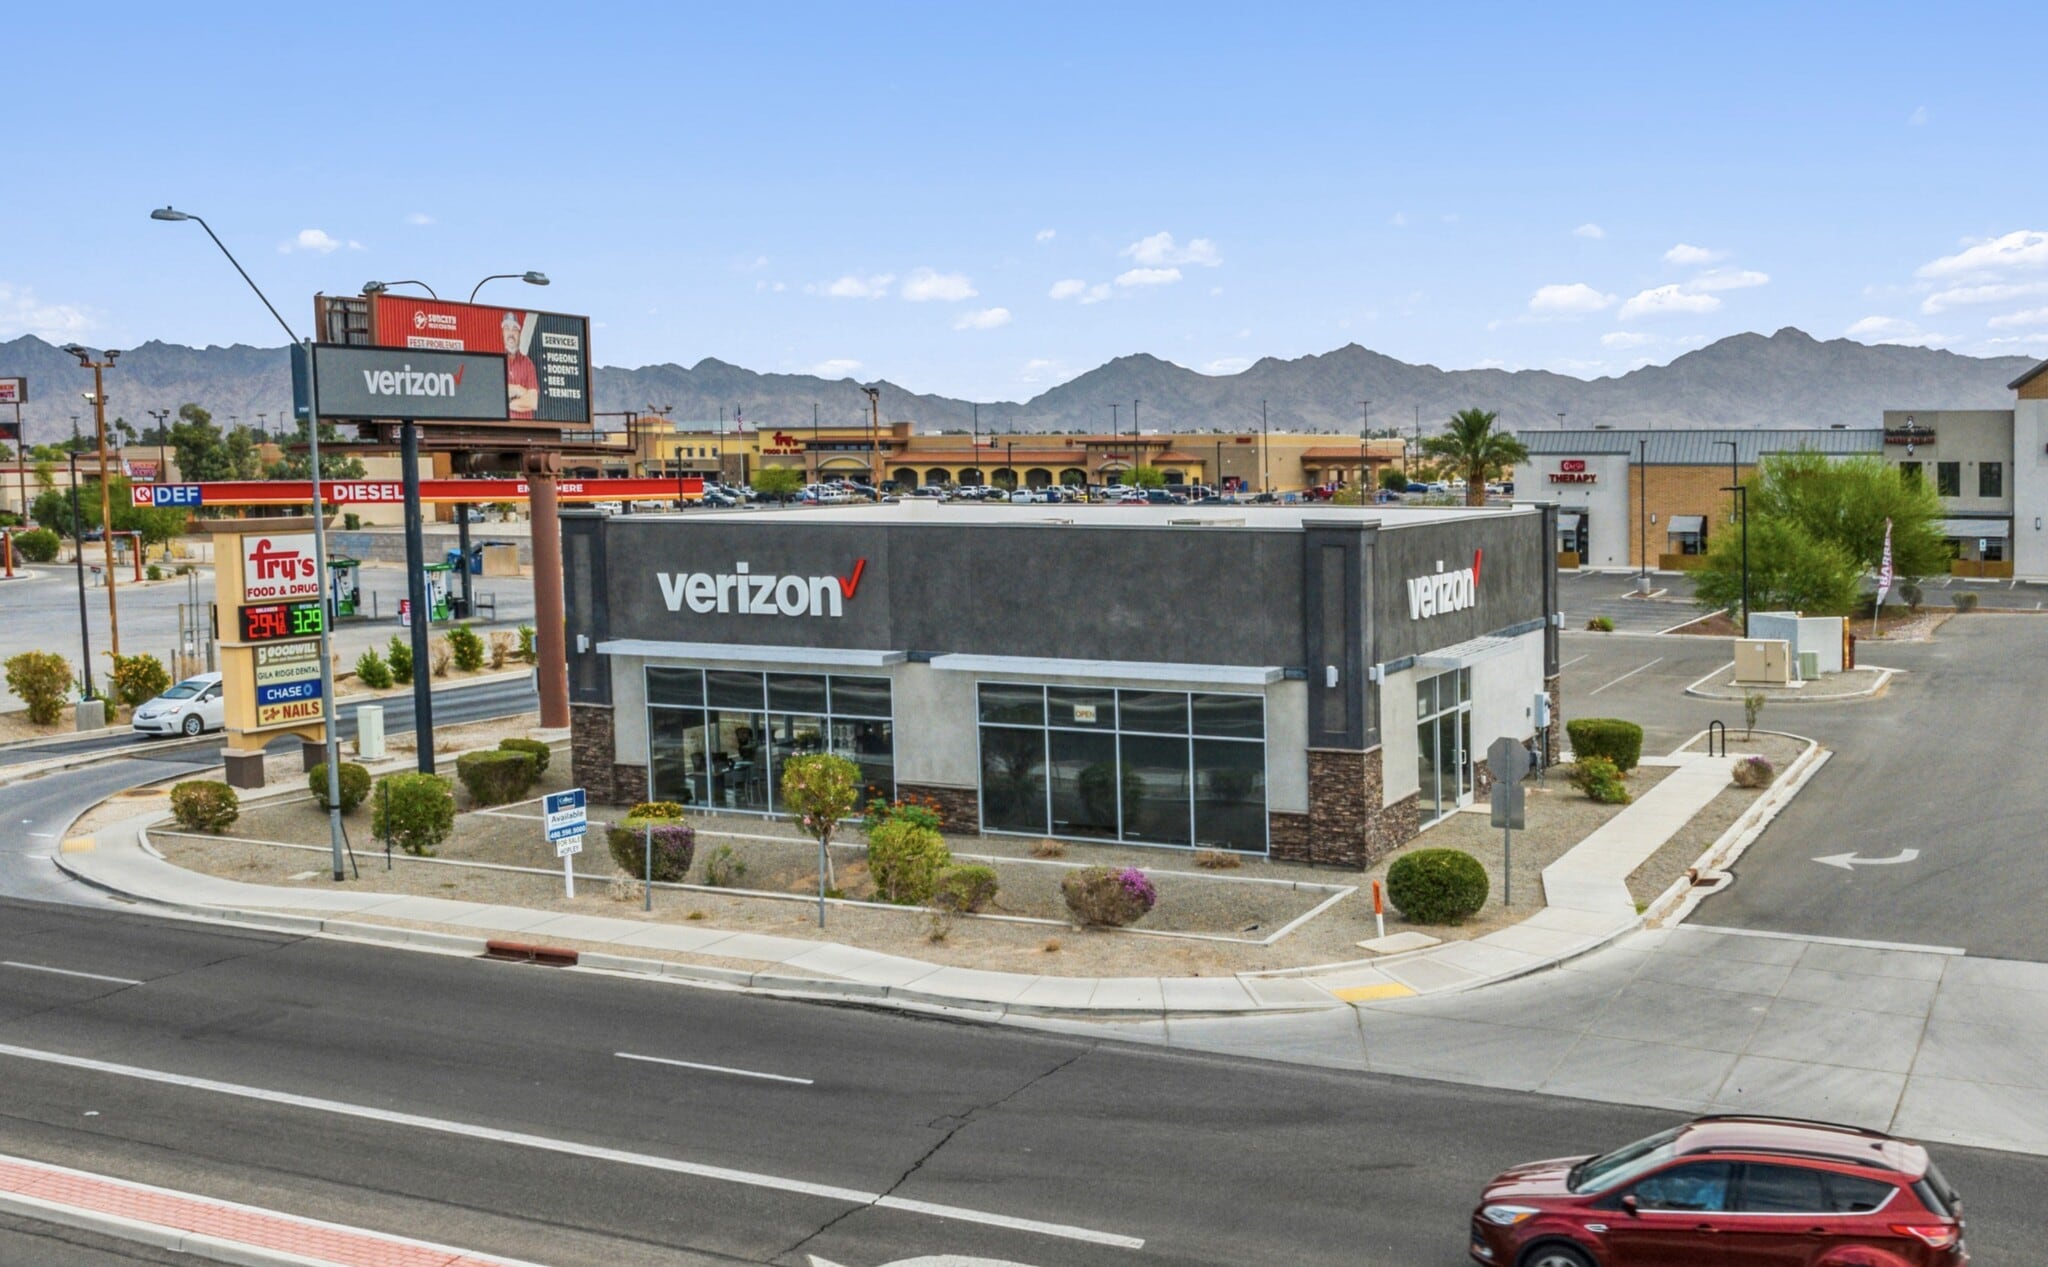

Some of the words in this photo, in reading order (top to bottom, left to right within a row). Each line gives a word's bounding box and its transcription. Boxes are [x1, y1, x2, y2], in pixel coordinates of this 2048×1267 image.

[547, 352, 578, 363] PIGEONS
[547, 364, 579, 376] RODENTS
[363, 364, 455, 397] verizon
[548, 375, 566, 386] BEES
[548, 387, 581, 399] TERMITES
[1549, 473, 1597, 484] THERAPY
[156, 486, 199, 503] DEF
[333, 484, 404, 501] DIESEL
[249, 539, 315, 581] fry's
[247, 586, 276, 597] FOOD
[279, 585, 287, 595] &
[290, 583, 318, 594] DRUG
[656, 562, 842, 617] verizon
[1406, 560, 1475, 620] verizon
[268, 642, 316, 657] GOODWILL
[258, 671, 273, 680] GILA
[275, 669, 294, 678] RIDGE
[296, 665, 319, 675] DENTAL
[267, 685, 302, 700] CHASE
[283, 701, 319, 718] NAILS
[551, 810, 584, 823] Available
